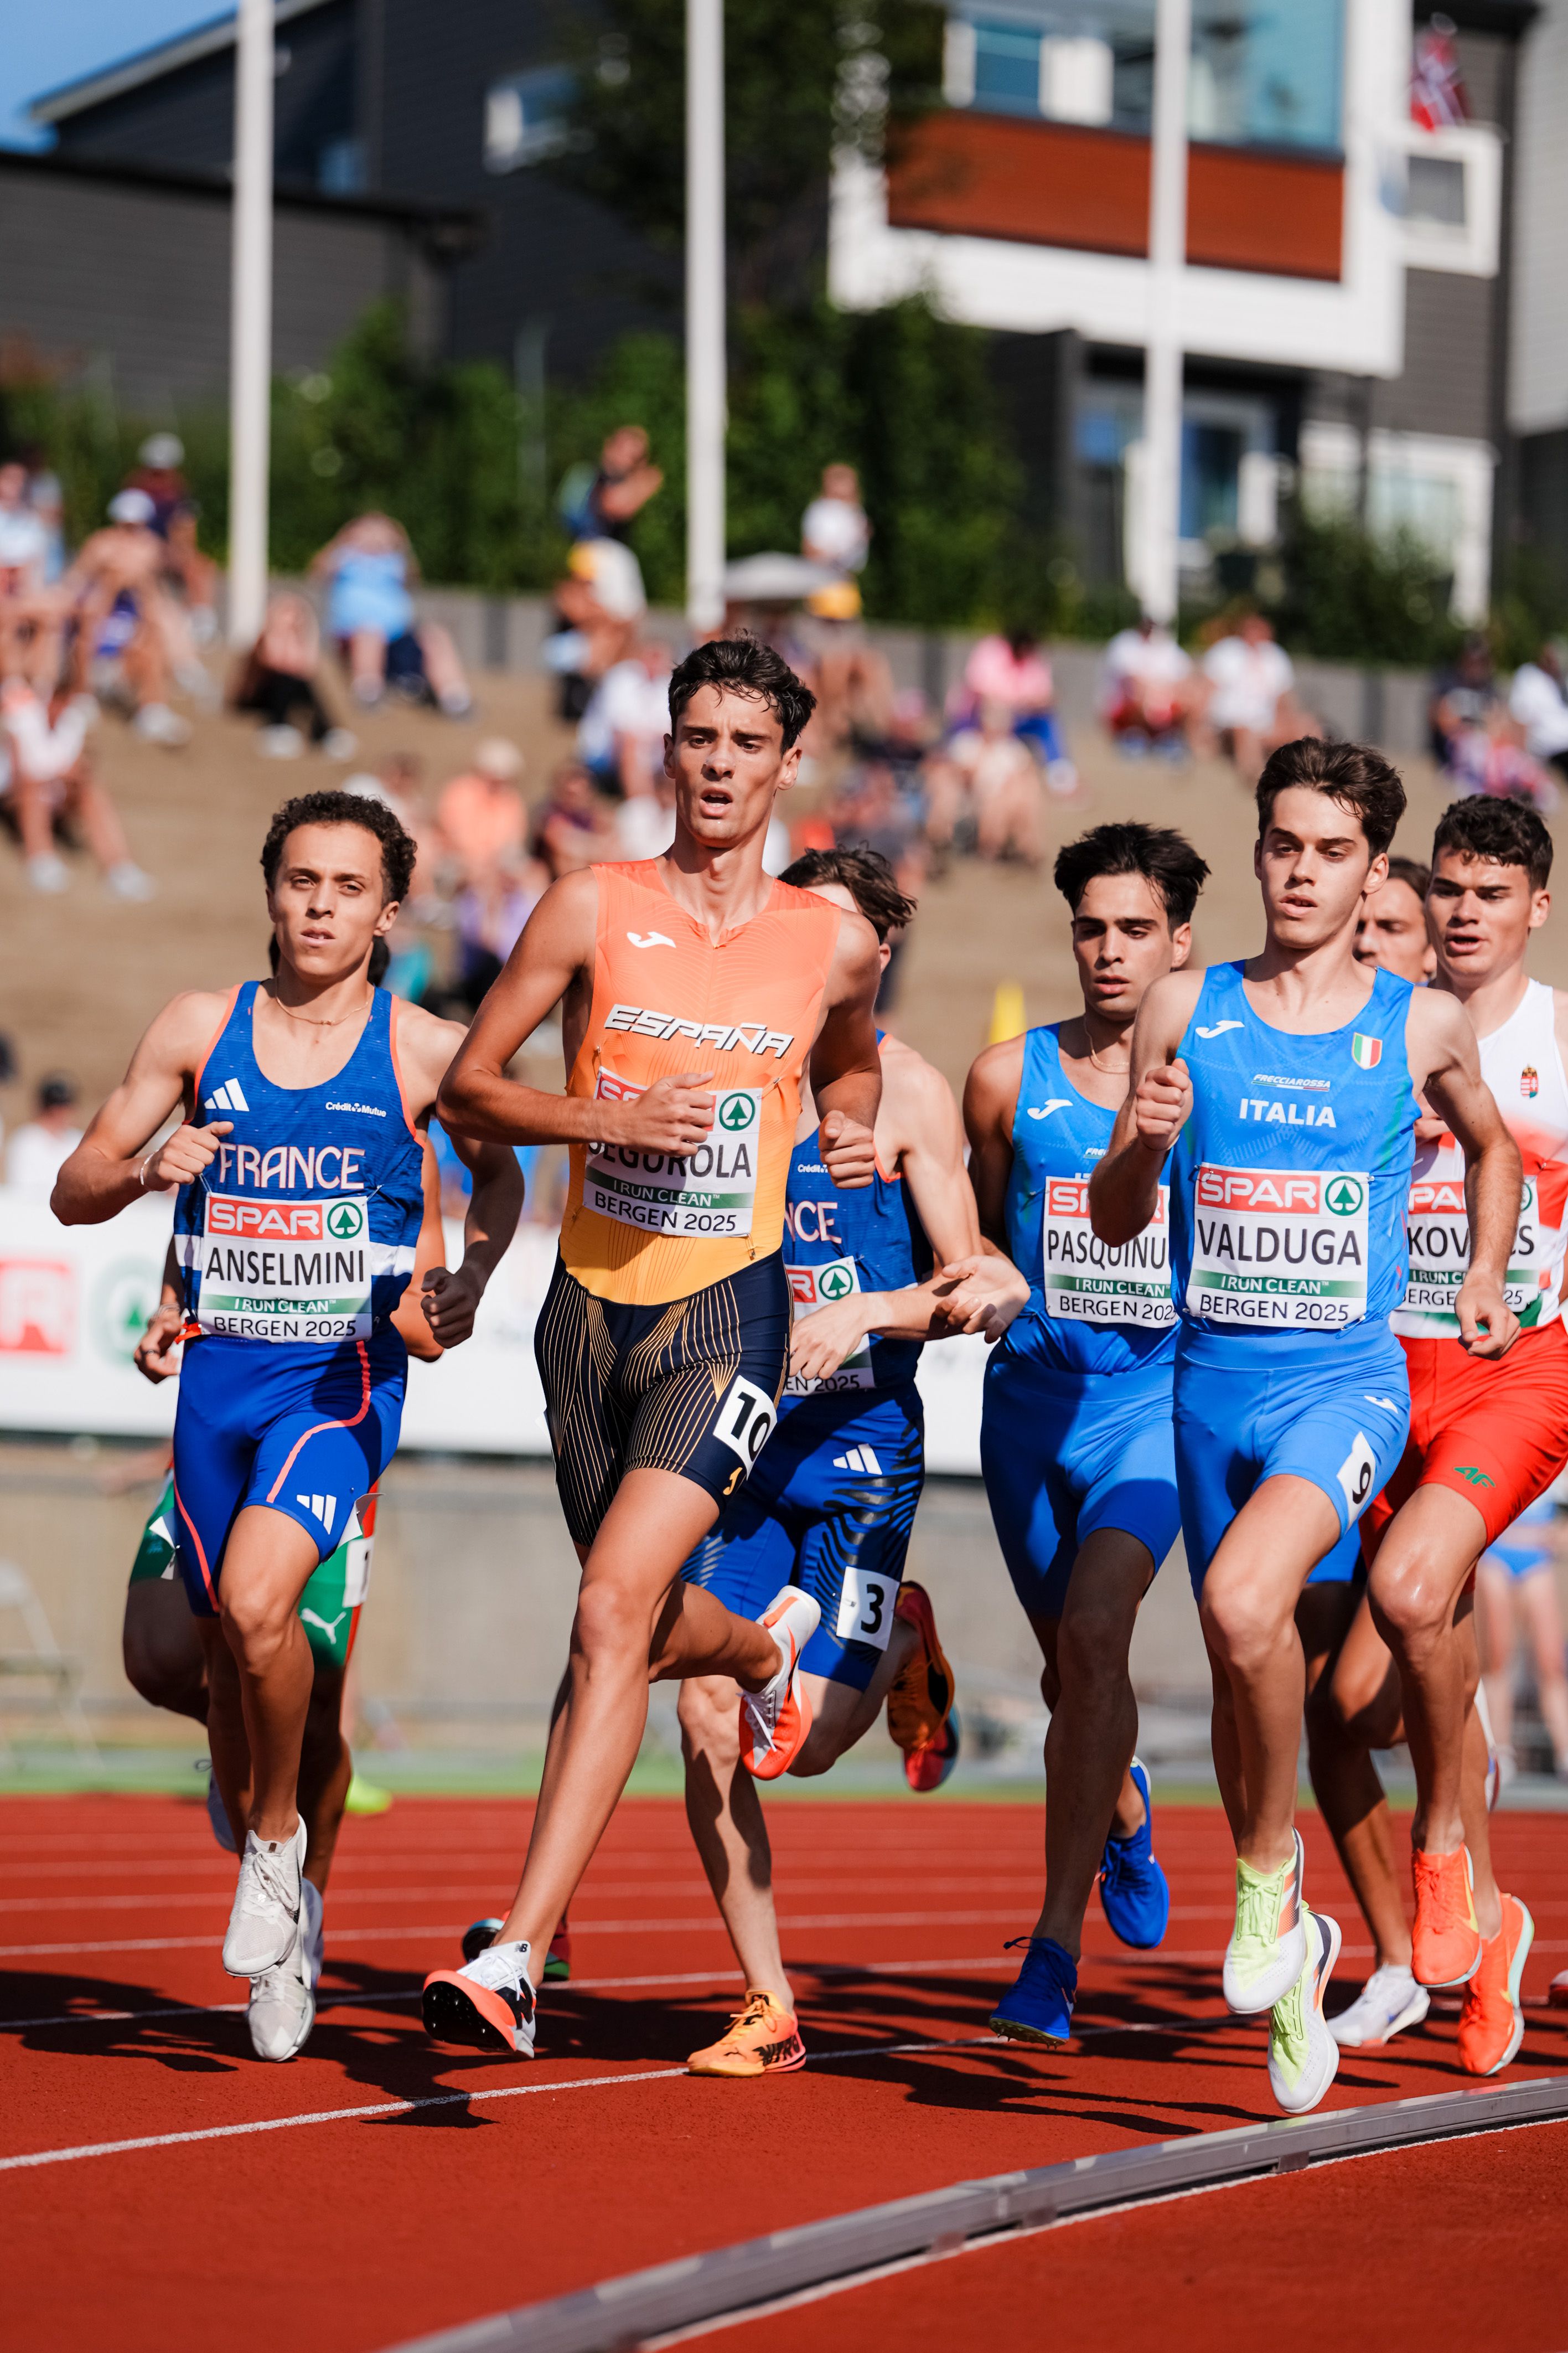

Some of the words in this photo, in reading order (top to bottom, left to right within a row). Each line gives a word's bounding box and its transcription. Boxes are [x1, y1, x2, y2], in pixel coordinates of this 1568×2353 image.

[604, 1003, 795, 1059] ESPAÑA
[1253, 1074, 1331, 1088] FRECCIAROSSA
[1239, 1098, 1337, 1128] ITALIA
[219, 1143, 366, 1190] FRANCE
[620, 1182, 653, 1201] RUN
[1200, 1174, 1317, 1208] SPAR
[211, 1201, 320, 1236] SPAR
[595, 1191, 677, 1228] BERGEN
[684, 1214, 737, 1232] 2025
[1197, 1219, 1362, 1266] VALDUGA
[205, 1248, 364, 1286] ANSELMINI
[1419, 1271, 1448, 1284] RUN
[1075, 1279, 1079, 1290] I
[1083, 1279, 1113, 1293] RUN
[1221, 1276, 1227, 1288] I
[1228, 1277, 1262, 1291] RUN
[242, 1299, 275, 1312] RUN
[1060, 1296, 1137, 1317] BERGEN
[1200, 1294, 1288, 1319] BERGEN
[1295, 1302, 1349, 1322] 2025
[214, 1317, 298, 1336] BERGEN
[306, 1320, 356, 1337] 2025
[815, 1375, 860, 1391] 2025
[731, 1391, 771, 1462] 10
[1353, 1462, 1371, 1505] 9
[861, 1583, 884, 1634] 3
